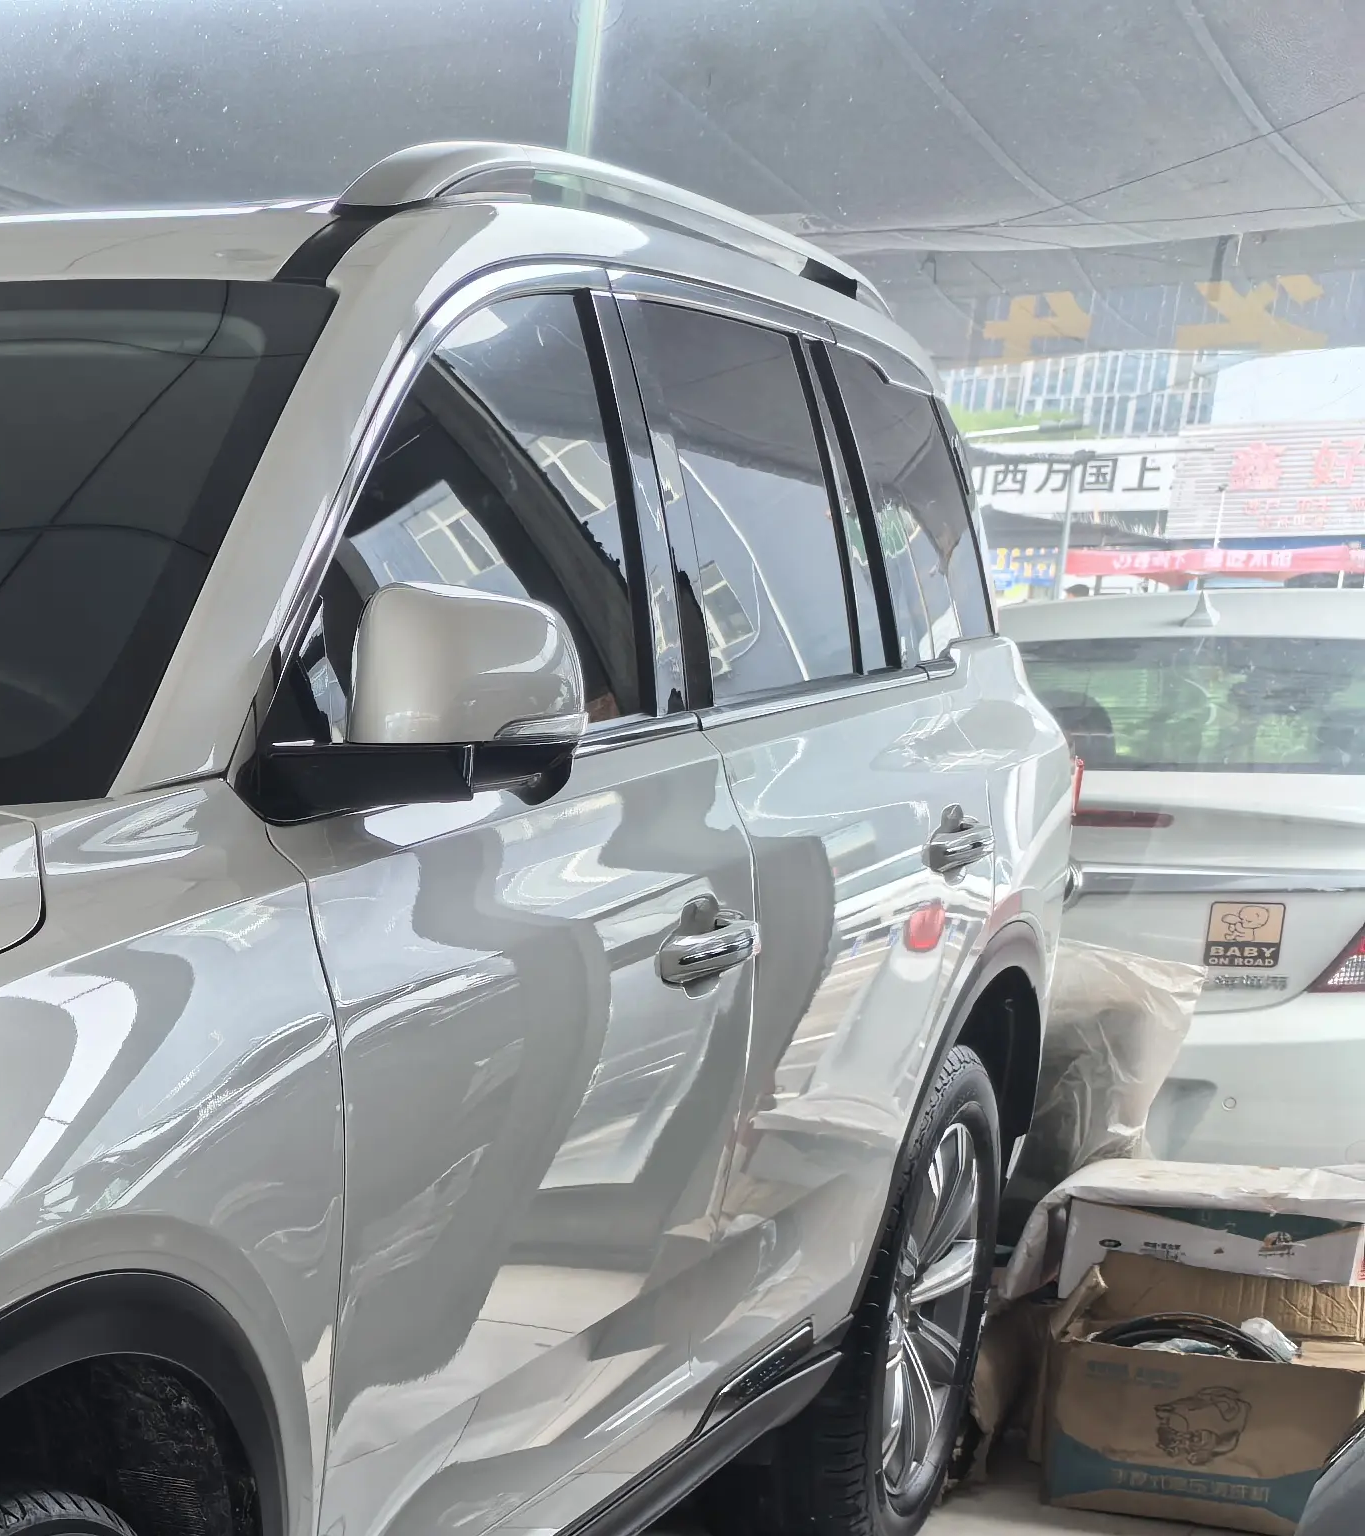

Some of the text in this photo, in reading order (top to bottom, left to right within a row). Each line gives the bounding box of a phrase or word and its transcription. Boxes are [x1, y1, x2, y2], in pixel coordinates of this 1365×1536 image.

[975, 456, 1173, 495] 西万国上
[1210, 946, 1276, 958] BABY
[1208, 957, 1274, 967] ON ROAD
